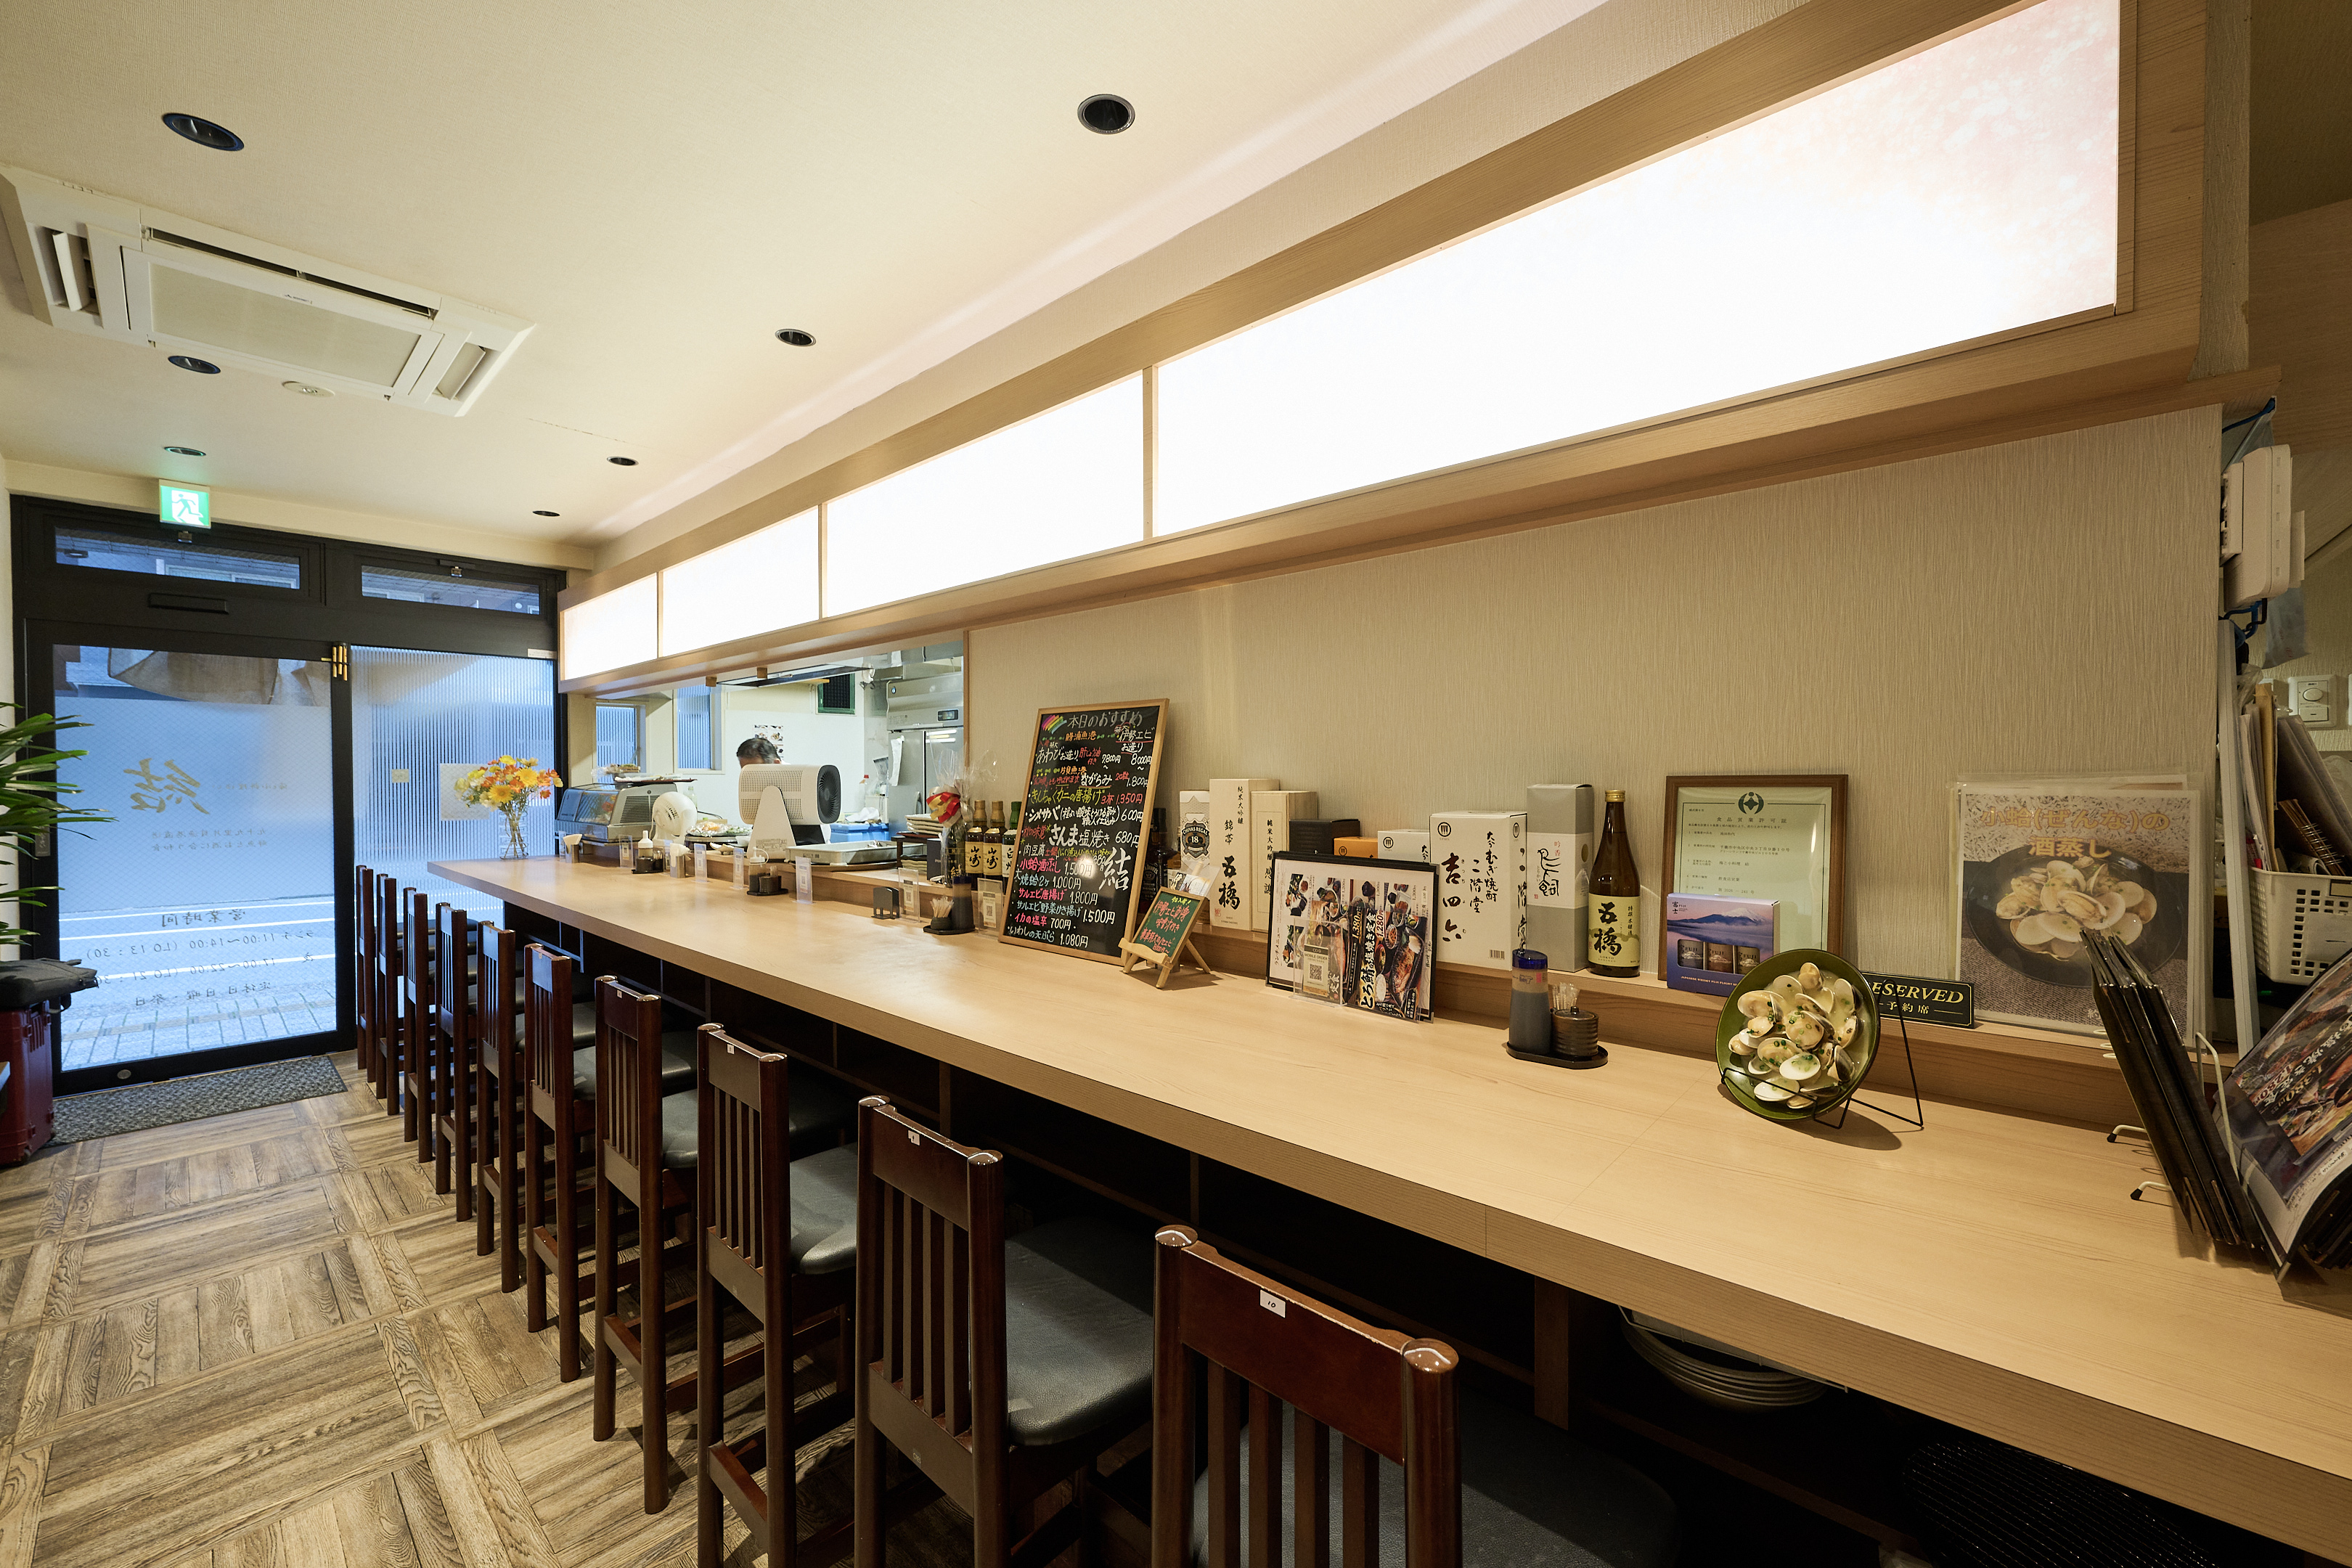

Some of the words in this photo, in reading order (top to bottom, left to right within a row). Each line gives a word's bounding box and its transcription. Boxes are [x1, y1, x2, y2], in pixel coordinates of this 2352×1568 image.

[1067, 711, 1143, 729] 本日のおすすめ
[1121, 742, 1143, 753] お造り
[1121, 809, 1144, 822] 600円
[1980, 806, 2171, 834] 小蛤(ぜんな)の
[1115, 831, 1140, 847] 680円
[1196, 826, 1209, 836] REGAL
[2028, 835, 2112, 859] 酒蒸し
[1098, 847, 1132, 891] 結
[1018, 887, 1068, 902] サルエビ唐揚げ
[1014, 912, 1048, 927] イカの塩辛
[1050, 918, 1071, 931] 700円
[1593, 902, 1622, 956] 五橋
[1871, 981, 1964, 1004] ESERVED
[1886, 1001, 1930, 1015] 予約席
